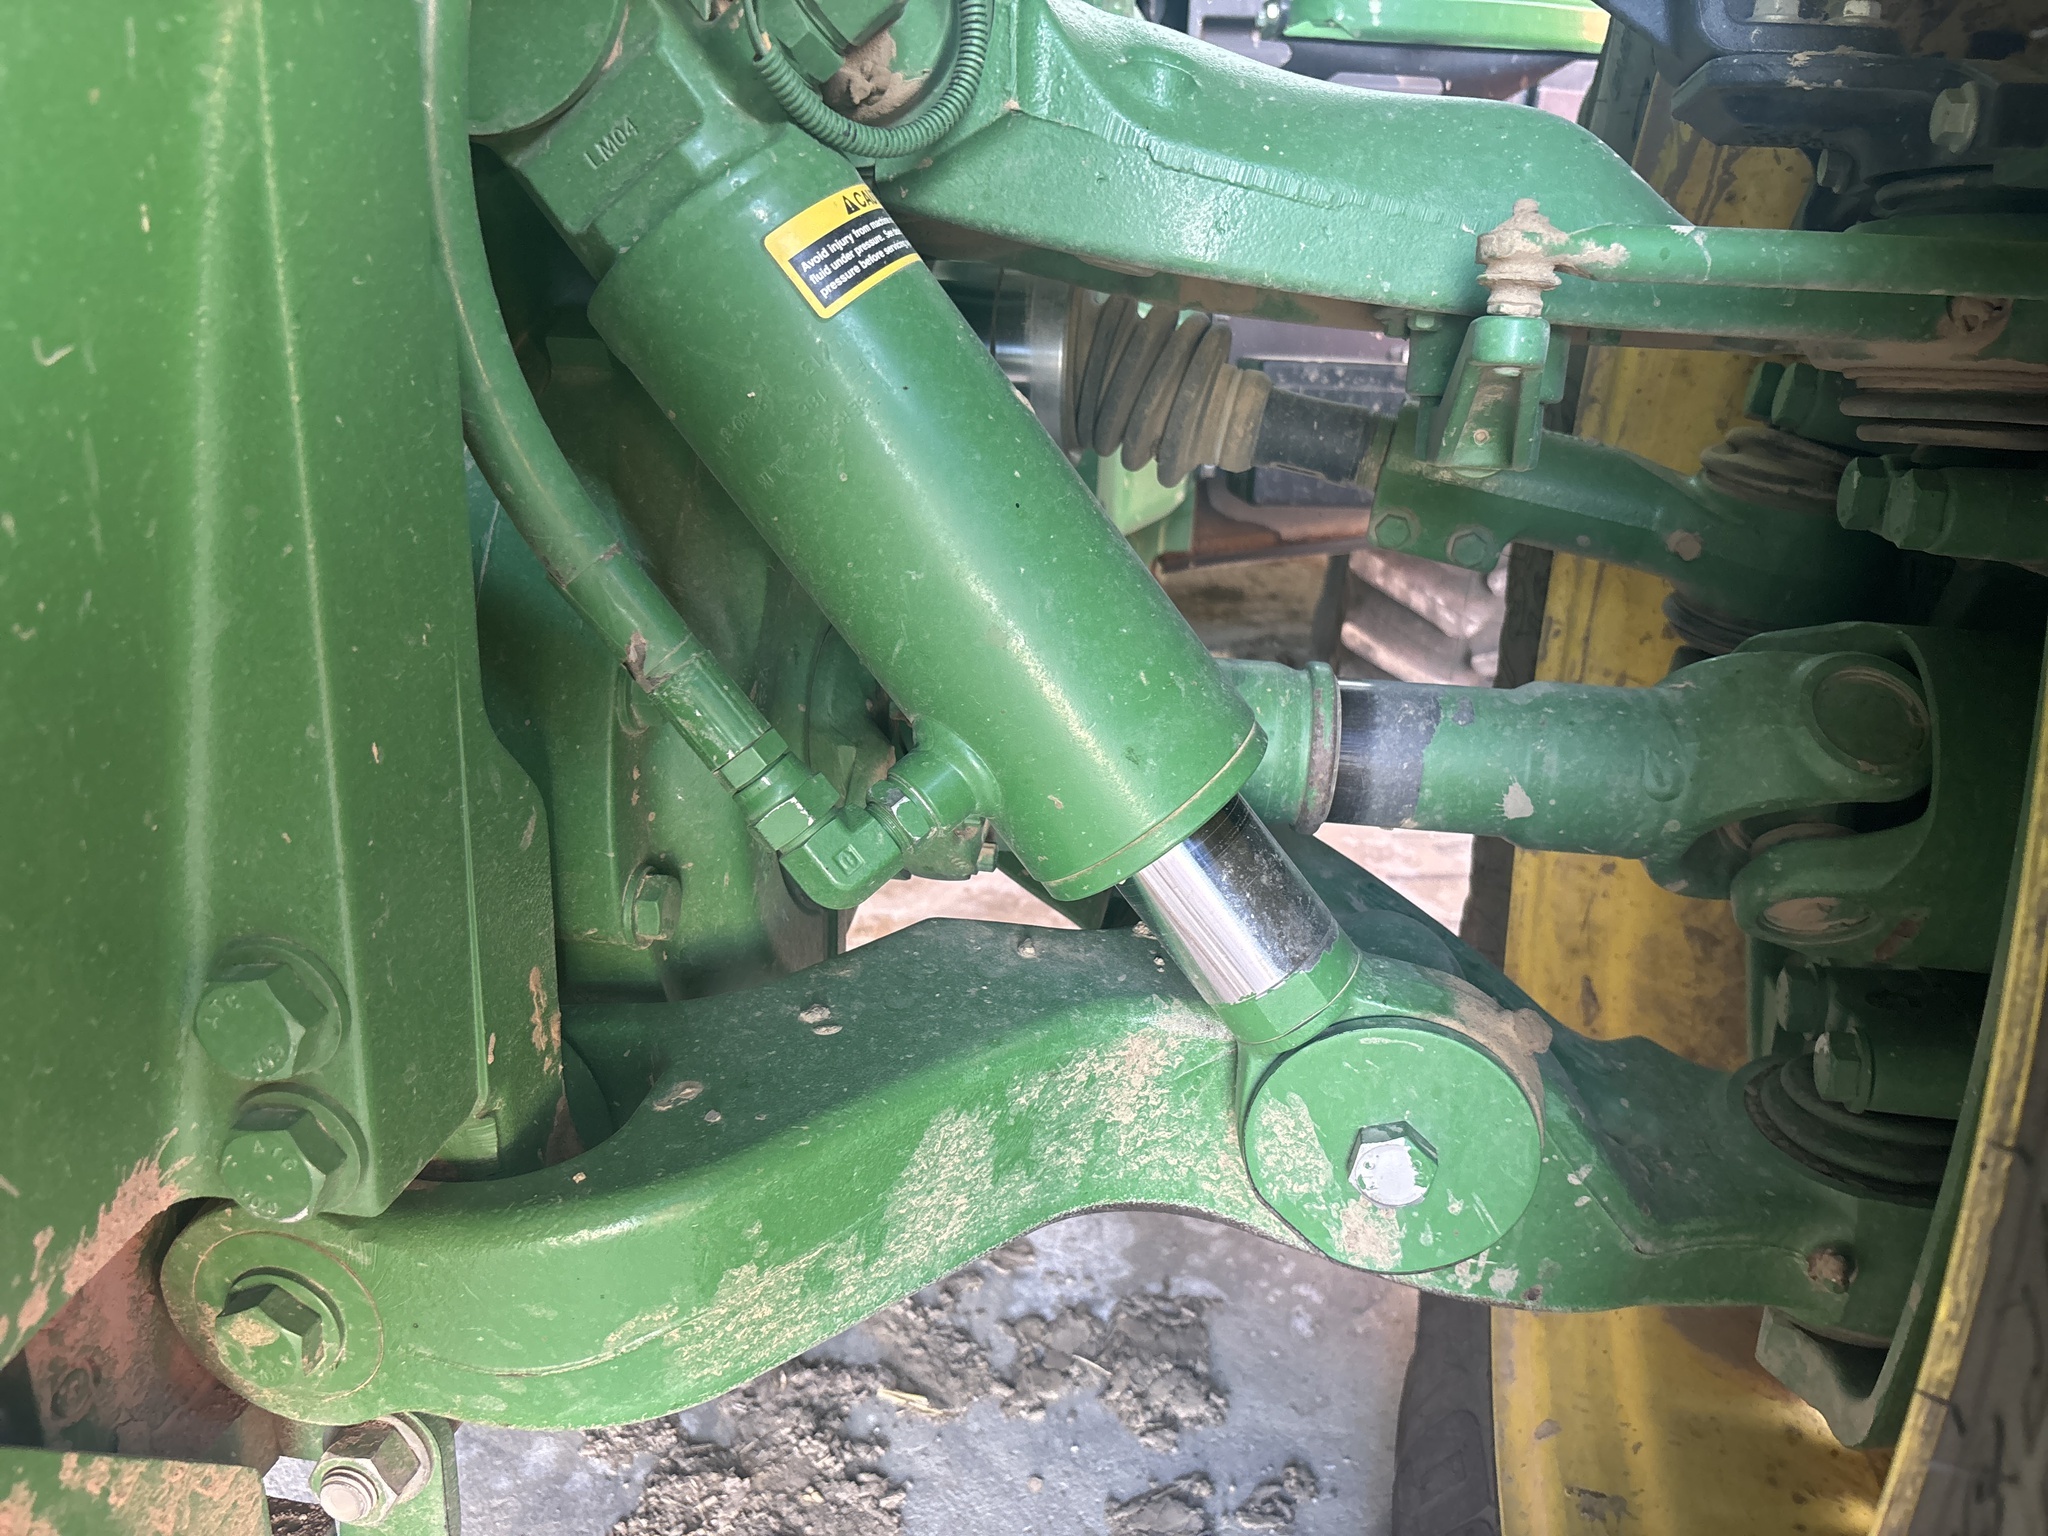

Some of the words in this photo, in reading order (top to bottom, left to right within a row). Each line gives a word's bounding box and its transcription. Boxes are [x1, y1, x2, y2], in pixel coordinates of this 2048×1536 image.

[583, 115, 639, 170] LM04
[853, 190, 879, 208] CAU
[801, 247, 830, 273] Avoid
[827, 233, 855, 253] injury
[852, 224, 871, 239] from
[809, 264, 832, 285] fluid
[830, 250, 855, 270] under
[854, 234, 886, 258] pressure.
[820, 265, 861, 299] pressure
[858, 250, 886, 269] before
